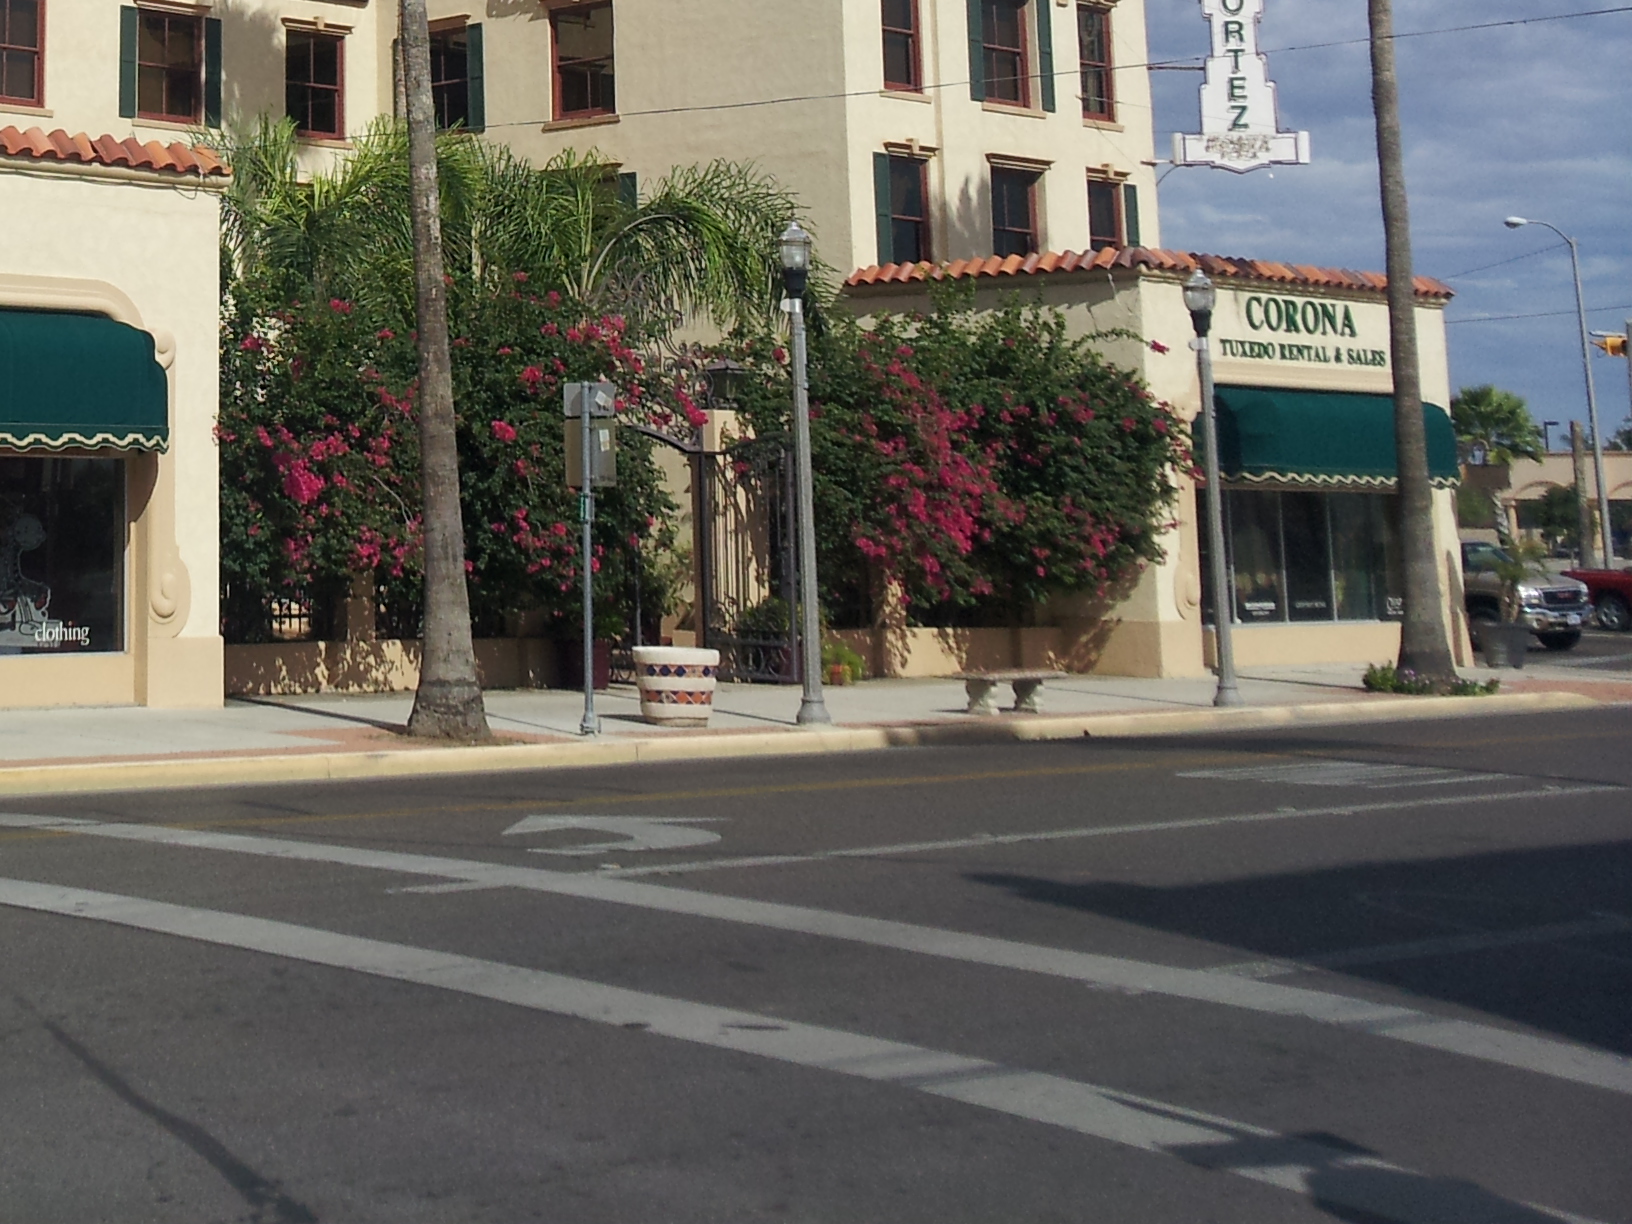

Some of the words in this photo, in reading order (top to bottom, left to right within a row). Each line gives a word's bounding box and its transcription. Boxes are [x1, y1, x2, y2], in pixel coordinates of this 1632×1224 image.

[1245, 296, 1358, 338] CORONA
[1220, 339, 1276, 360] TUXEDO
[1279, 343, 1331, 363] RENTAL
[1334, 347, 1344, 364] &
[1347, 348, 1386, 367] SALES
[34, 621, 90, 646] clothing
